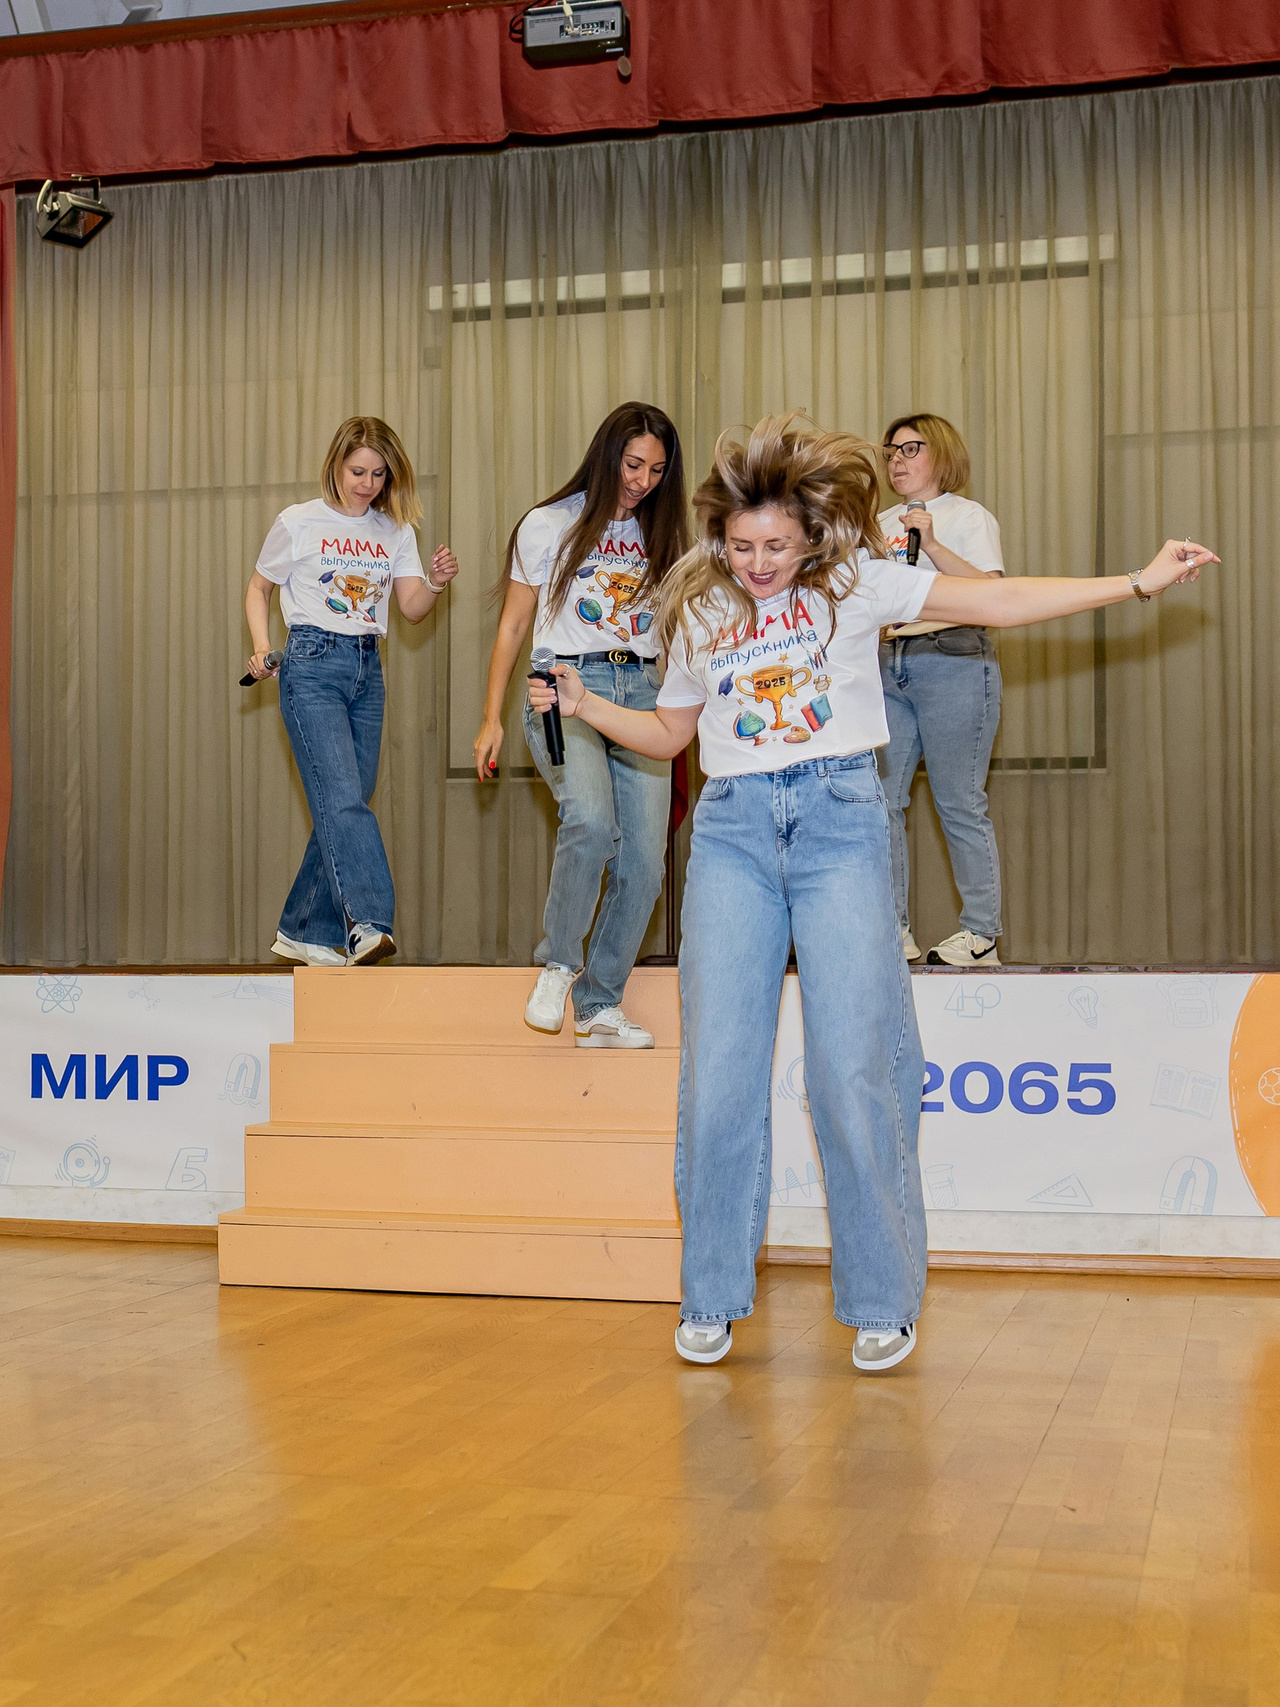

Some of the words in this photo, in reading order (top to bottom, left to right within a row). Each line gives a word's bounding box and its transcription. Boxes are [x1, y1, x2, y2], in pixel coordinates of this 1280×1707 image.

[321, 538, 389, 559] МАМА
[597, 539, 649, 559] АМ
[347, 583, 364, 593] 2025
[611, 581, 635, 594] 2025
[710, 629, 818, 671] выпускника
[756, 676, 786, 690] 2025
[30, 1053, 190, 1101] МИР
[921, 1061, 1117, 1116] 2065
